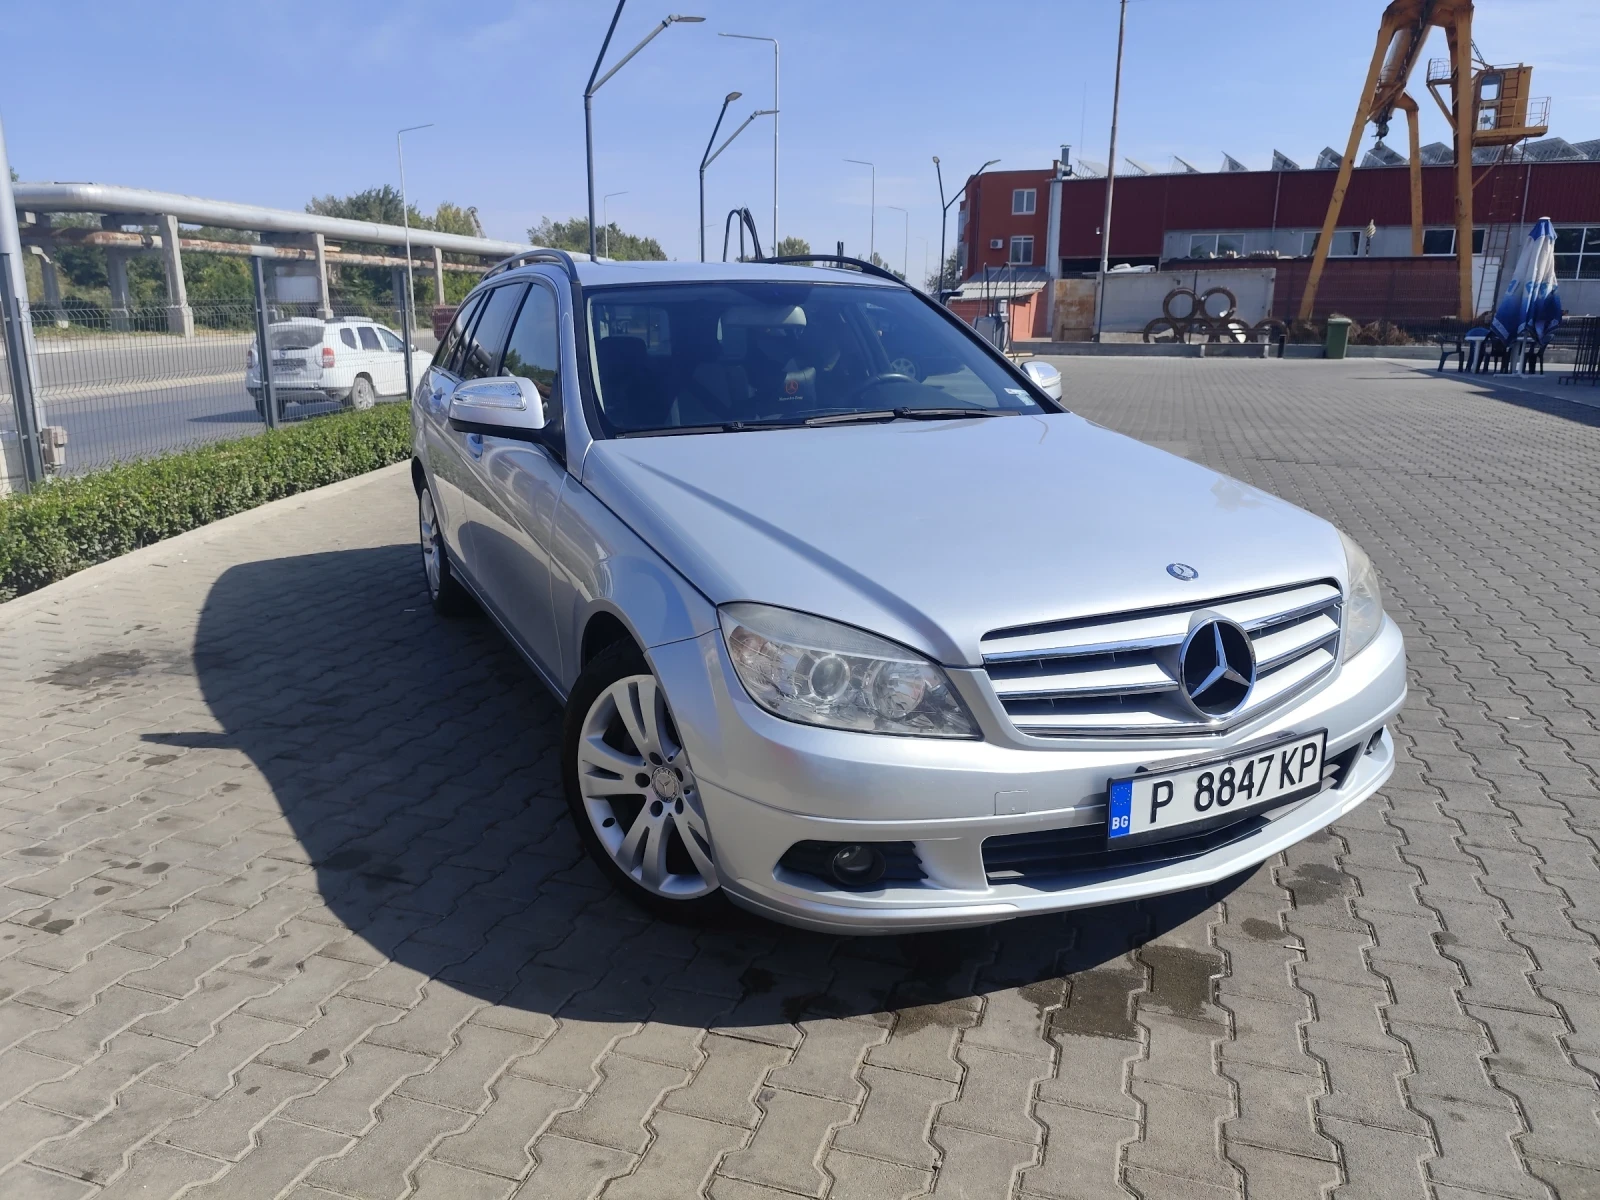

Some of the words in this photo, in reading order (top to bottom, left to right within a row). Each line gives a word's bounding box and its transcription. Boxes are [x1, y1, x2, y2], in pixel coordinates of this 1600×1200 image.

[1149, 780, 1174, 824] P
[1194, 754, 1275, 812] 8847
[1279, 742, 1317, 790] KP
[1111, 815, 1129, 830] BG
